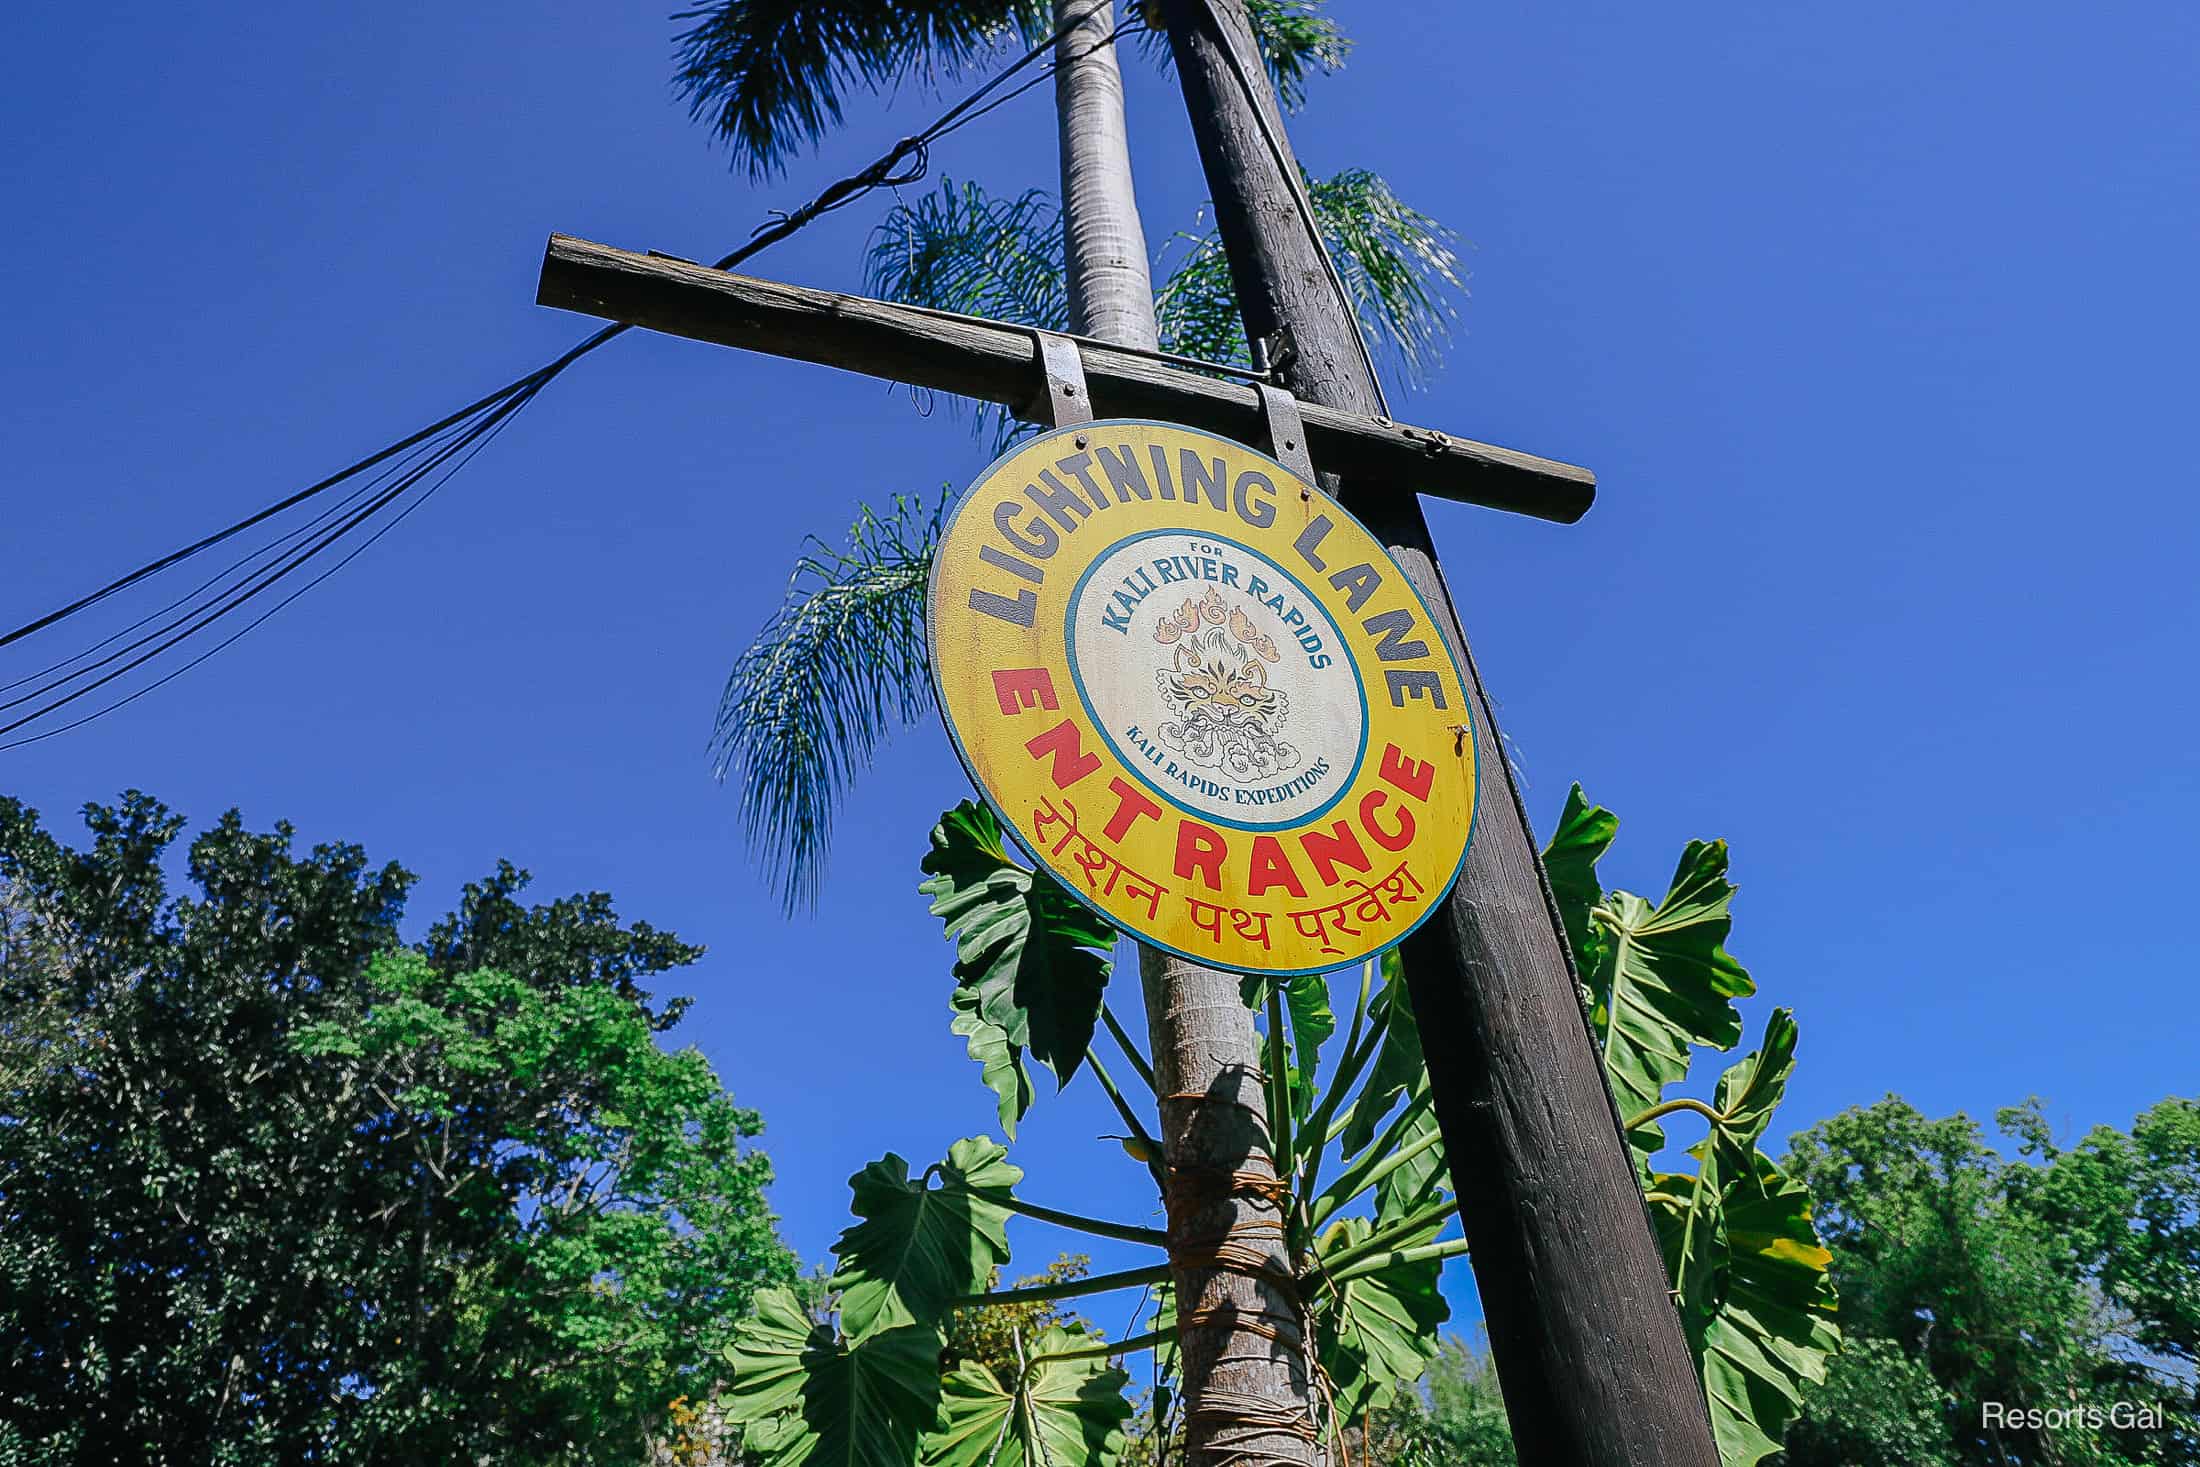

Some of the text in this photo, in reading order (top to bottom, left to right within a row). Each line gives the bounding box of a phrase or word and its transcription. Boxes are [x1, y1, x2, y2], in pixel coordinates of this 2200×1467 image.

[968, 444, 1448, 710] LIGHTNING LANE
[1101, 555, 1332, 670] KALI RIVER RAPIDS
[1189, 542, 1223, 557] FOR
[991, 667, 1436, 898] ENTRANCE
[1125, 725, 1332, 806] KALI RAPIDS EXPEDITIONS
[1033, 794, 1170, 921] रोशन
[1184, 896, 1273, 951] पथ
